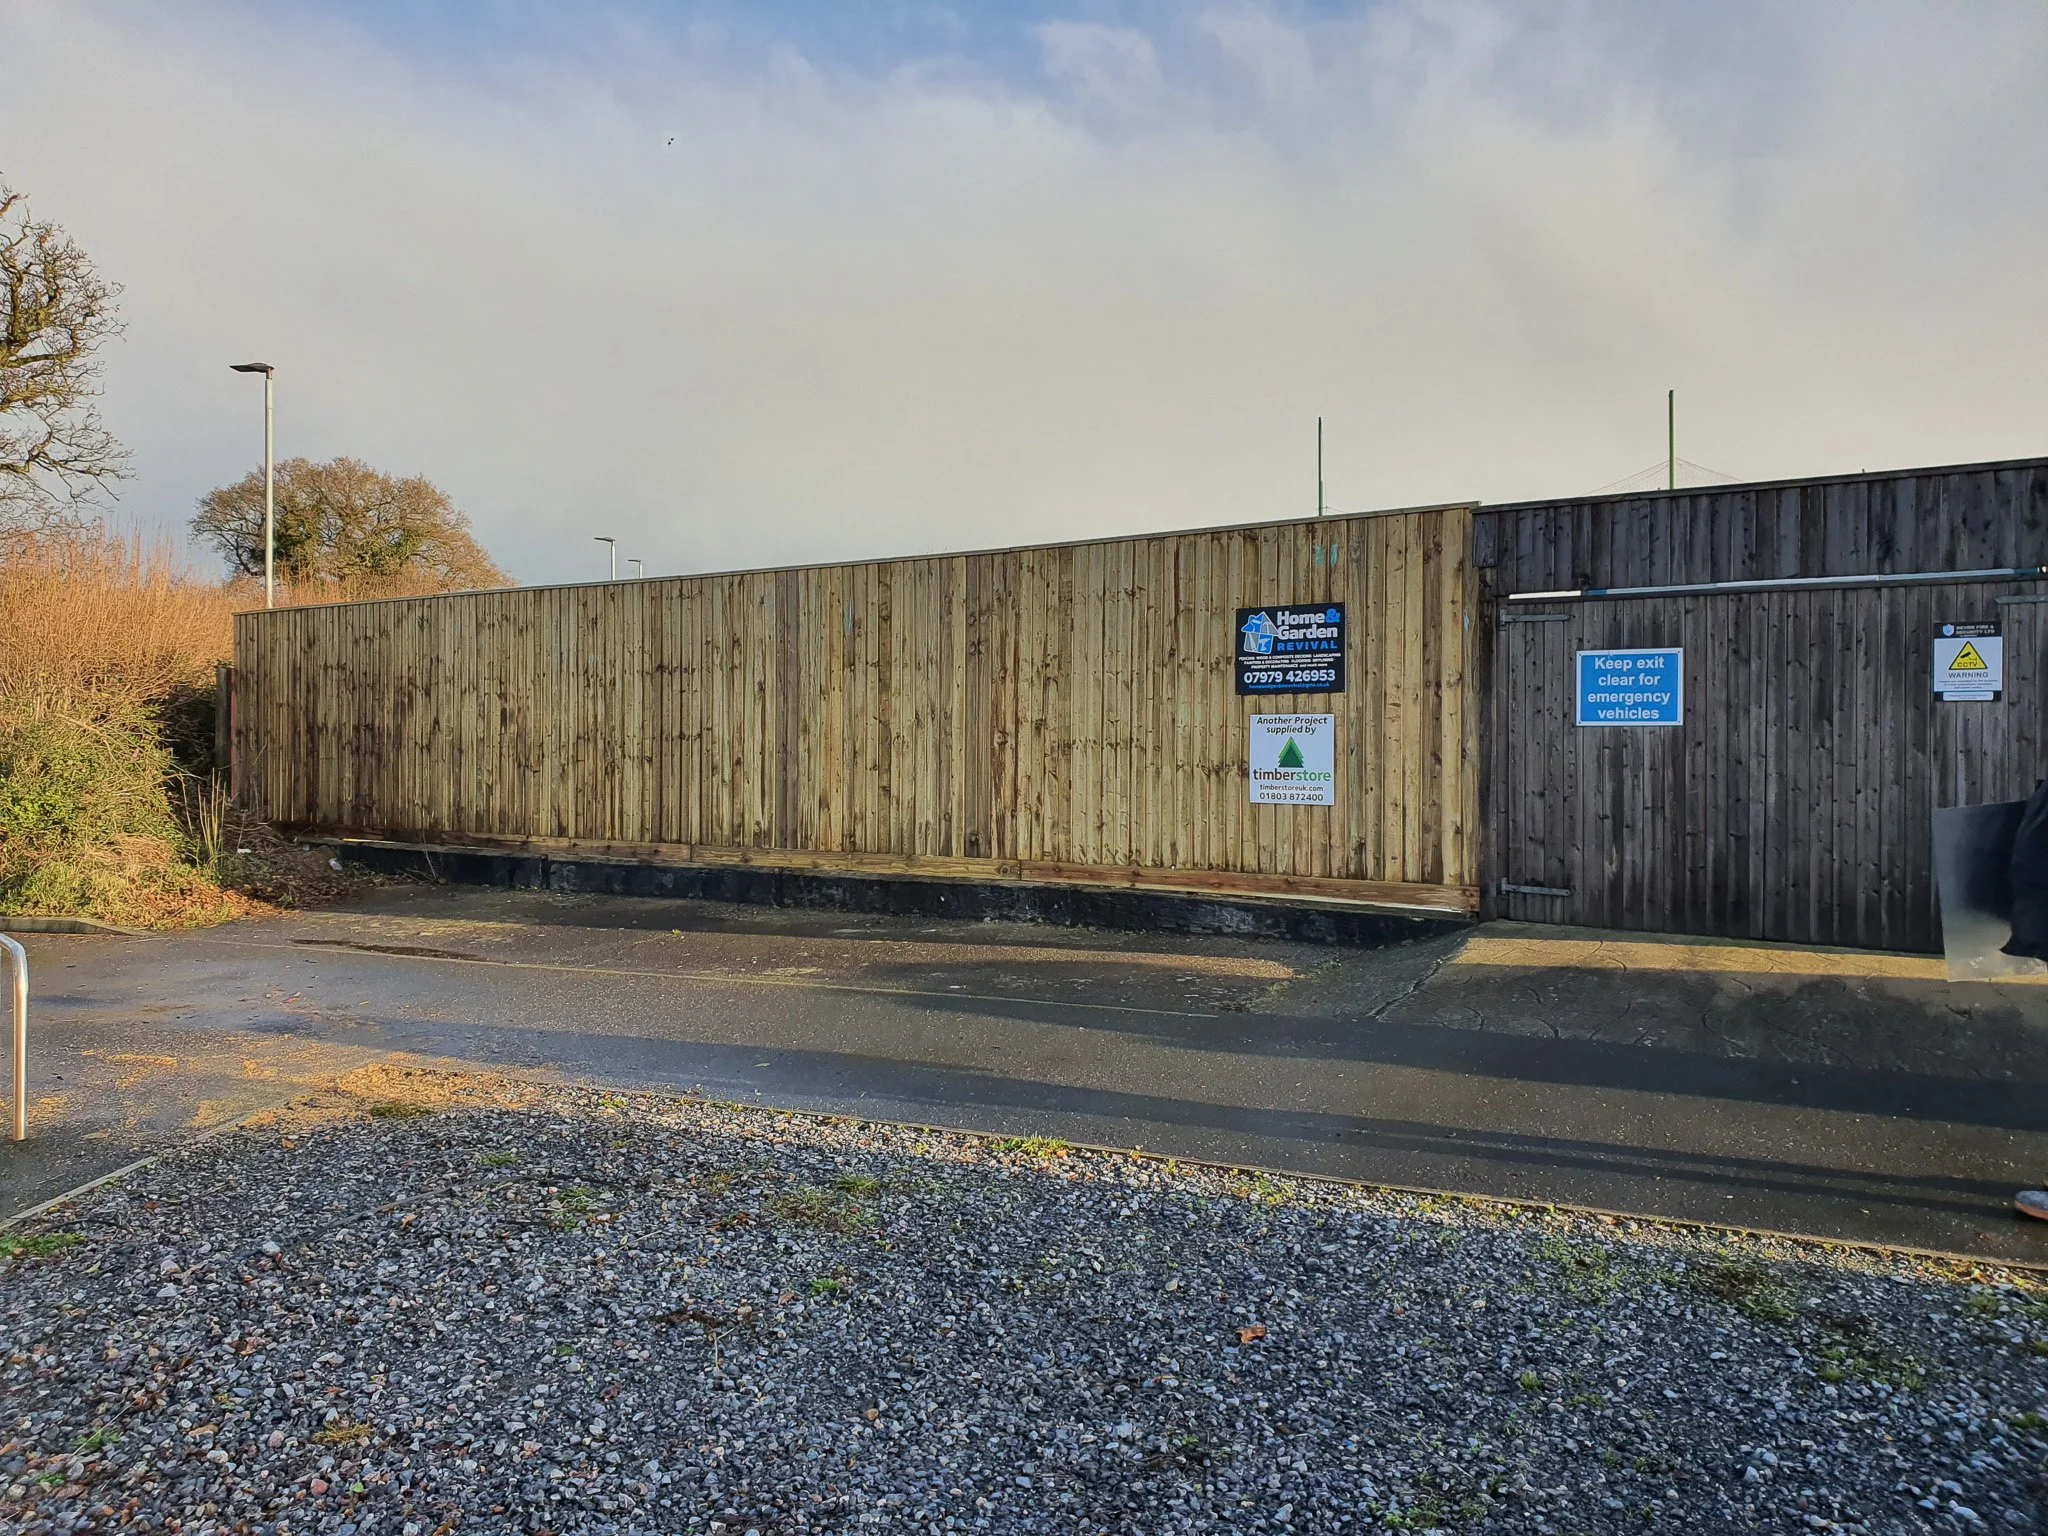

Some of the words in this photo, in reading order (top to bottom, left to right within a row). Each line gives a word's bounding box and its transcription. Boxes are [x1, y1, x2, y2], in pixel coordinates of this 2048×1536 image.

[1277, 624, 1338, 640] Garden
[1277, 640, 1338, 651] REVIVAL
[1594, 657, 1632, 672] Keep
[1636, 656, 1664, 669] exit
[1244, 671, 1283, 684] 07979
[1286, 669, 1335, 682] 426953
[1598, 674, 1635, 686] clear
[1639, 673, 1660, 685] for
[1948, 671, 1989, 679] WARNING
[1587, 692, 1671, 705] emergency
[1597, 707, 1660, 719] vehicles
[1256, 716, 1292, 725] Another
[1294, 716, 1328, 726] Project
[1266, 725, 1303, 735] supplied
[1304, 725, 1316, 735] by
[1252, 768, 1331, 782] timberstore
[1259, 784, 1324, 792] timberstoreuk.com
[1259, 792, 1287, 800] 01803
[1289, 793, 1324, 802] 872400
